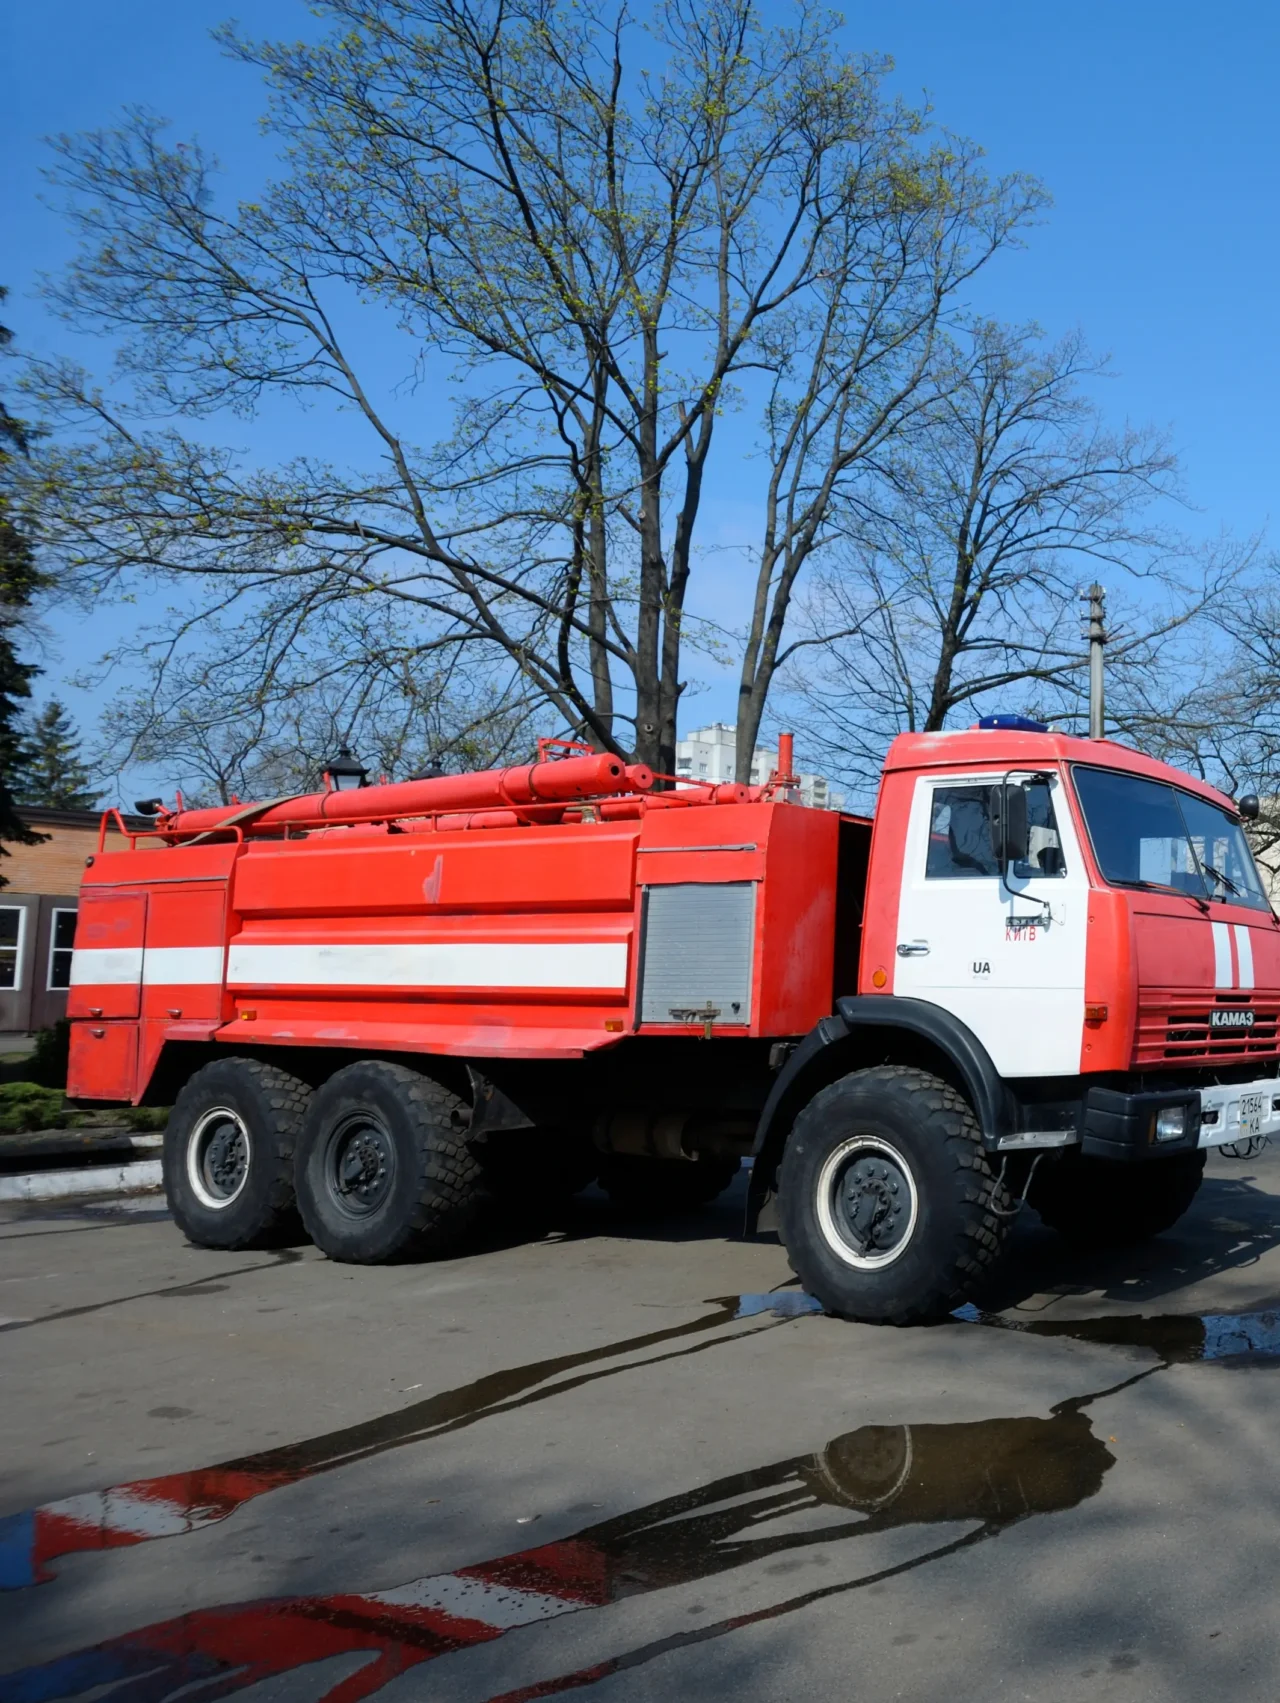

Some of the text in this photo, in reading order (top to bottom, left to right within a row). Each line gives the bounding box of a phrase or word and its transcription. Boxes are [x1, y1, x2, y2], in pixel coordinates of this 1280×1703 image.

[973, 962, 991, 974] UA
[1212, 1011, 1254, 1026] КАМАЗ
[1242, 1096, 1262, 1115] 21564
